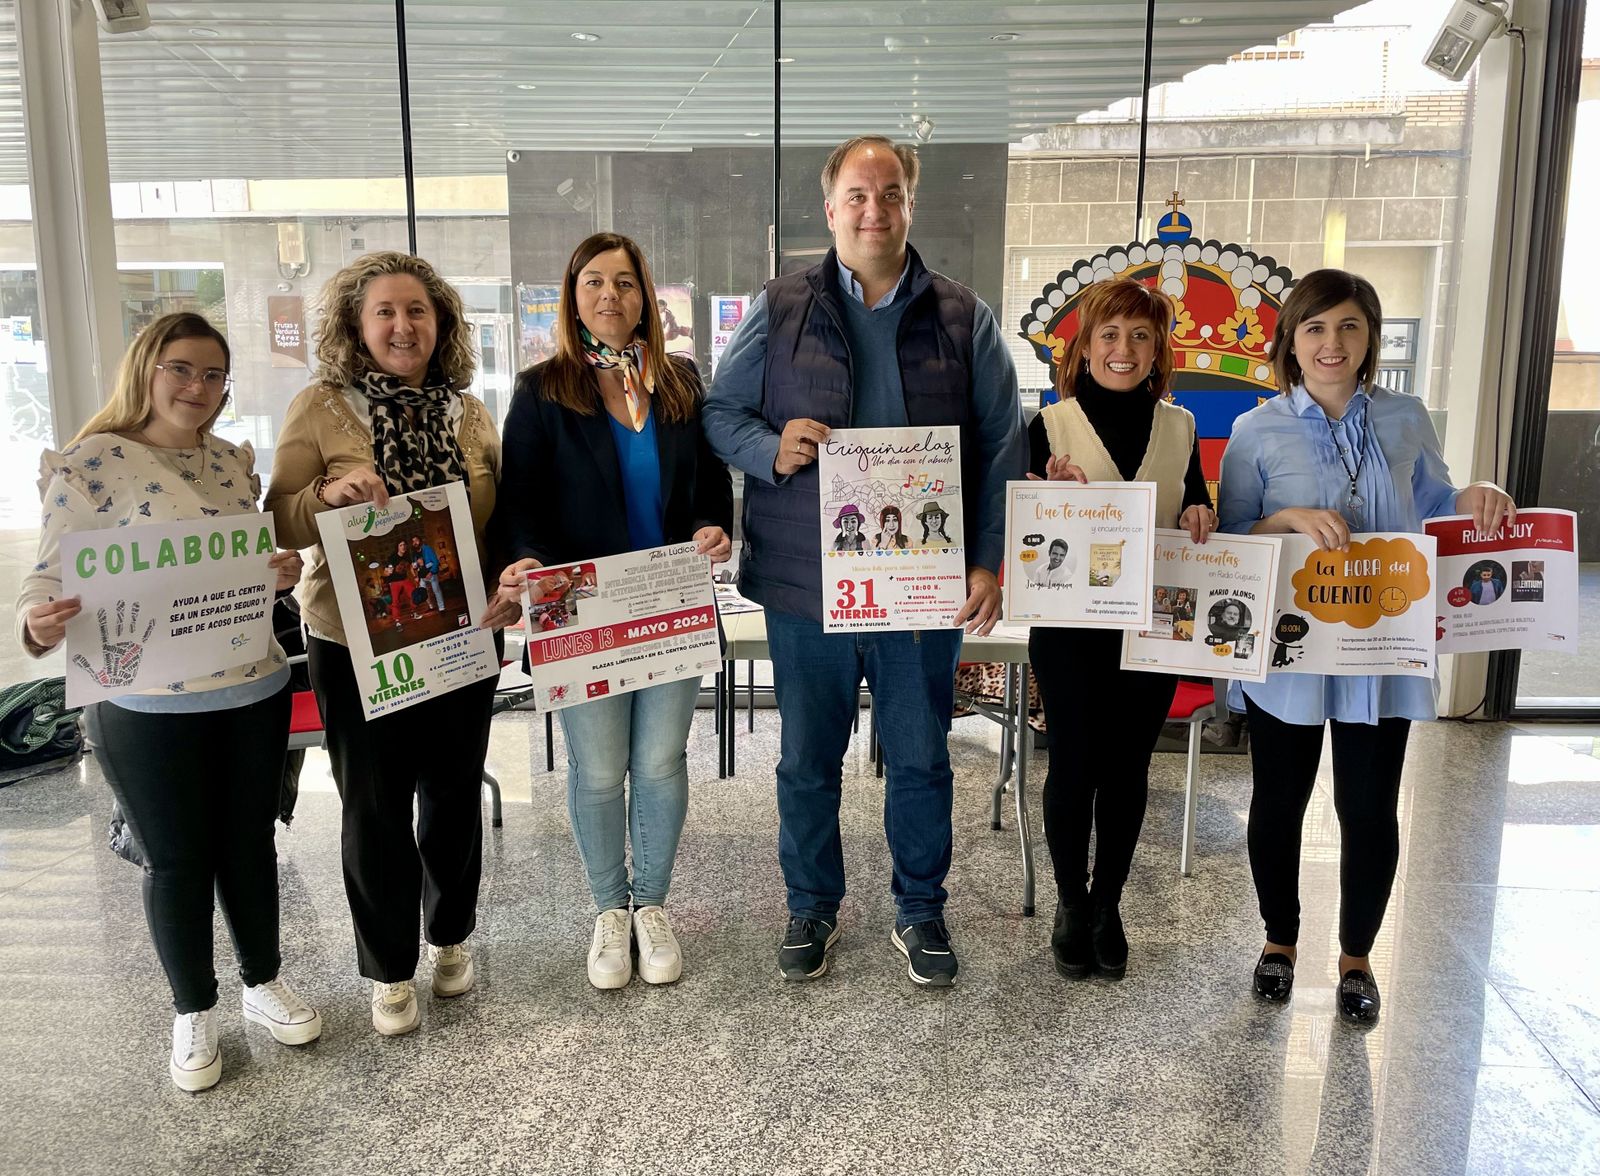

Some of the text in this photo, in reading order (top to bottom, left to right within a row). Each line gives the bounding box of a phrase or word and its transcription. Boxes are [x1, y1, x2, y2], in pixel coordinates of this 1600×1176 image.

[277, 340, 300, 348] Tejedor
[715, 336, 728, 344] 26
[919, 456, 926, 465] el
[928, 454, 953, 464] abuelo
[1035, 502, 1125, 521] Que te cuentas
[1510, 523, 1534, 539] JUY
[76, 526, 274, 578] COLABORA
[668, 545, 696, 556] Lúdico
[1176, 546, 1194, 562] te
[1196, 549, 1241, 568] cuentas
[1344, 558, 1382, 577] HORA
[1388, 560, 1410, 576] del
[172, 584, 266, 608] AYUDA A QUE EL CENTRO
[836, 578, 878, 610] 31
[1209, 589, 1255, 600] MARIO ALONSO
[1308, 585, 1372, 604] CUENTO
[170, 613, 185, 622] SEA
[188, 610, 198, 620] UN
[200, 604, 232, 617] ESPACIO
[234, 598, 260, 610] SEGURO
[830, 608, 888, 620] VIERNES
[171, 610, 264, 637] LIBRE DE ACOSO ESCOLAR
[426, 628, 481, 648] TEATRO CENTRO CULTU
[542, 614, 708, 662] LUNES 13 MAYO 2024
[592, 661, 615, 670] PLAZAS
[616, 654, 644, 665] LIMITADAS
[666, 646, 687, 655] CENTRO
[689, 640, 716, 649] CULTURAL
[370, 652, 414, 692] 10
[368, 678, 425, 705] VIERNES
[370, 706, 385, 714] MAYO
